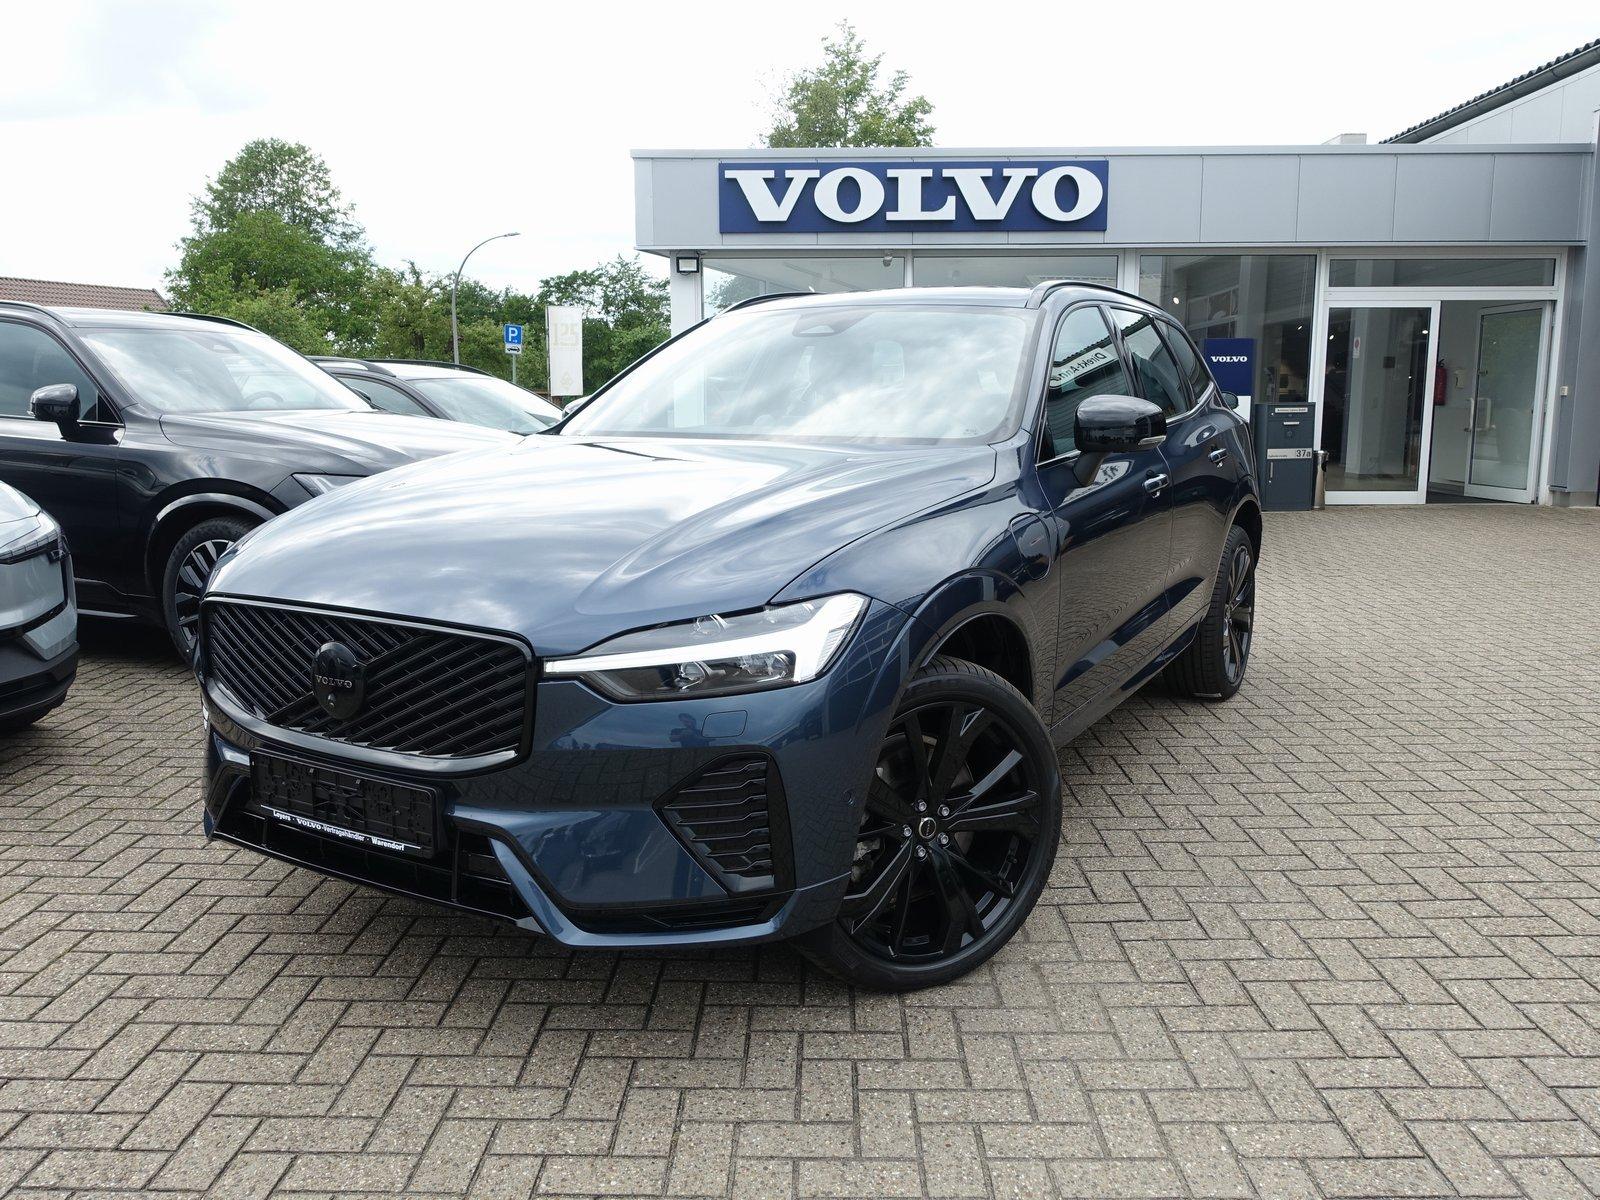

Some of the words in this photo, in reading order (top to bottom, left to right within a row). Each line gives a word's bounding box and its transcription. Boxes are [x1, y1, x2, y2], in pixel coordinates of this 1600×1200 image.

[724, 165, 1103, 223] VOLVO
[508, 327, 518, 342] P
[1210, 355, 1248, 363] VOLVO
[1296, 449, 1311, 458] 37a
[315, 674, 353, 688] VOLVO
[371, 836, 405, 852] Warendorf
